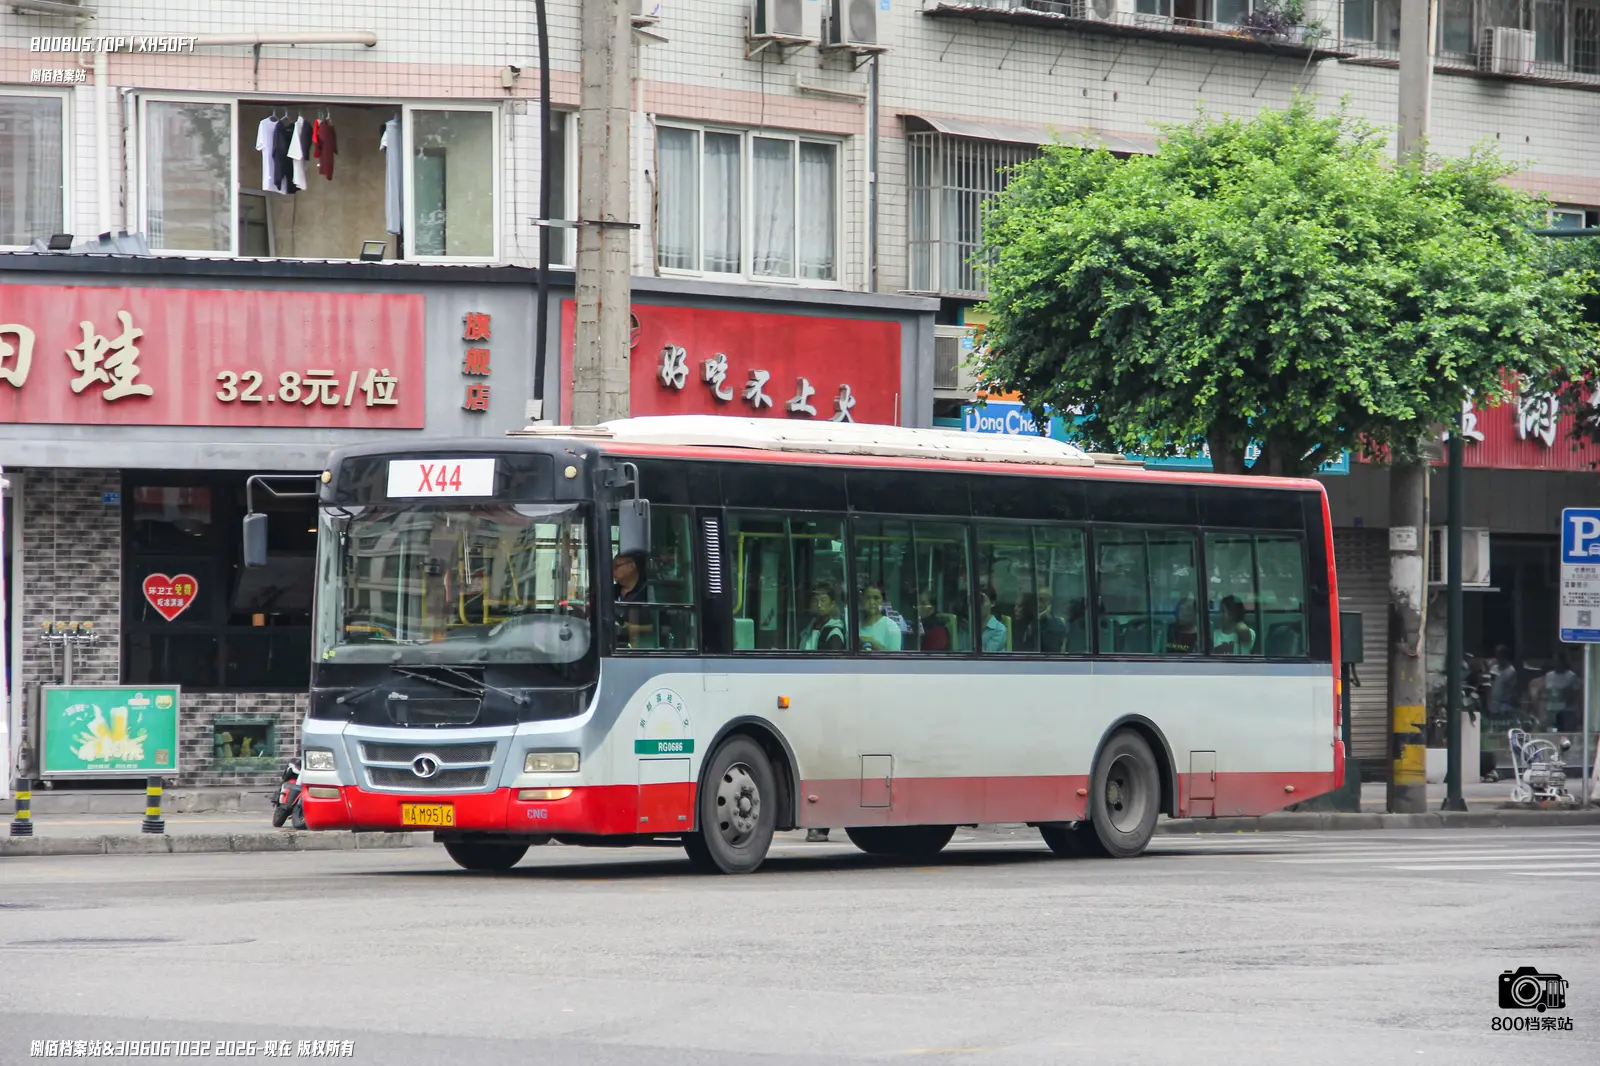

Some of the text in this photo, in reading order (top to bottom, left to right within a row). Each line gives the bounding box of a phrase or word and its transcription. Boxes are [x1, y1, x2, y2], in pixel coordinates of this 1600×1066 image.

[461, 312, 492, 411] 旗舰店
[216, 368, 399, 407] 32.8元/位
[417, 464, 462, 493] X44
[1568, 516, 1600, 557] P
[526, 808, 549, 819] CNG
